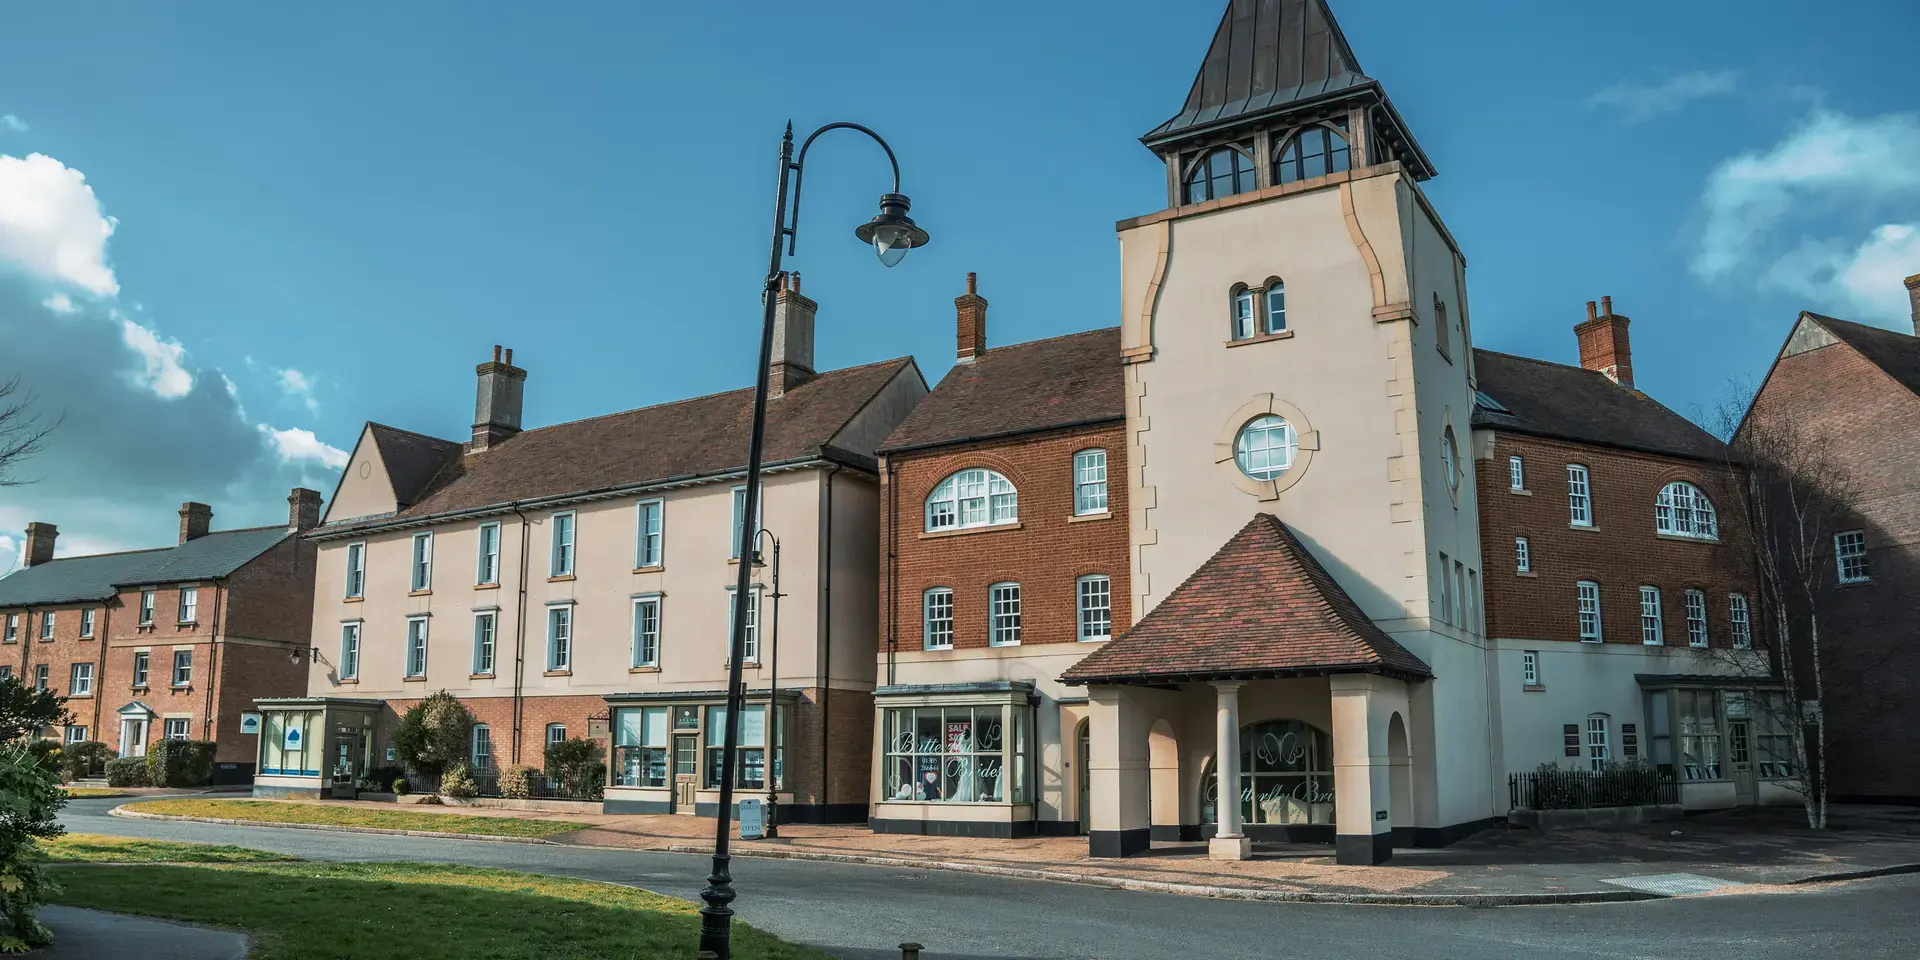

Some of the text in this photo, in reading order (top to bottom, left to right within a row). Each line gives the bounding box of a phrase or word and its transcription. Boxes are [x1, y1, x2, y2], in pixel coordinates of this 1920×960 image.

[948, 724, 969, 732] SALE
[946, 757, 1002, 778] Brides
[1206, 780, 1335, 809] tterfly Bri
